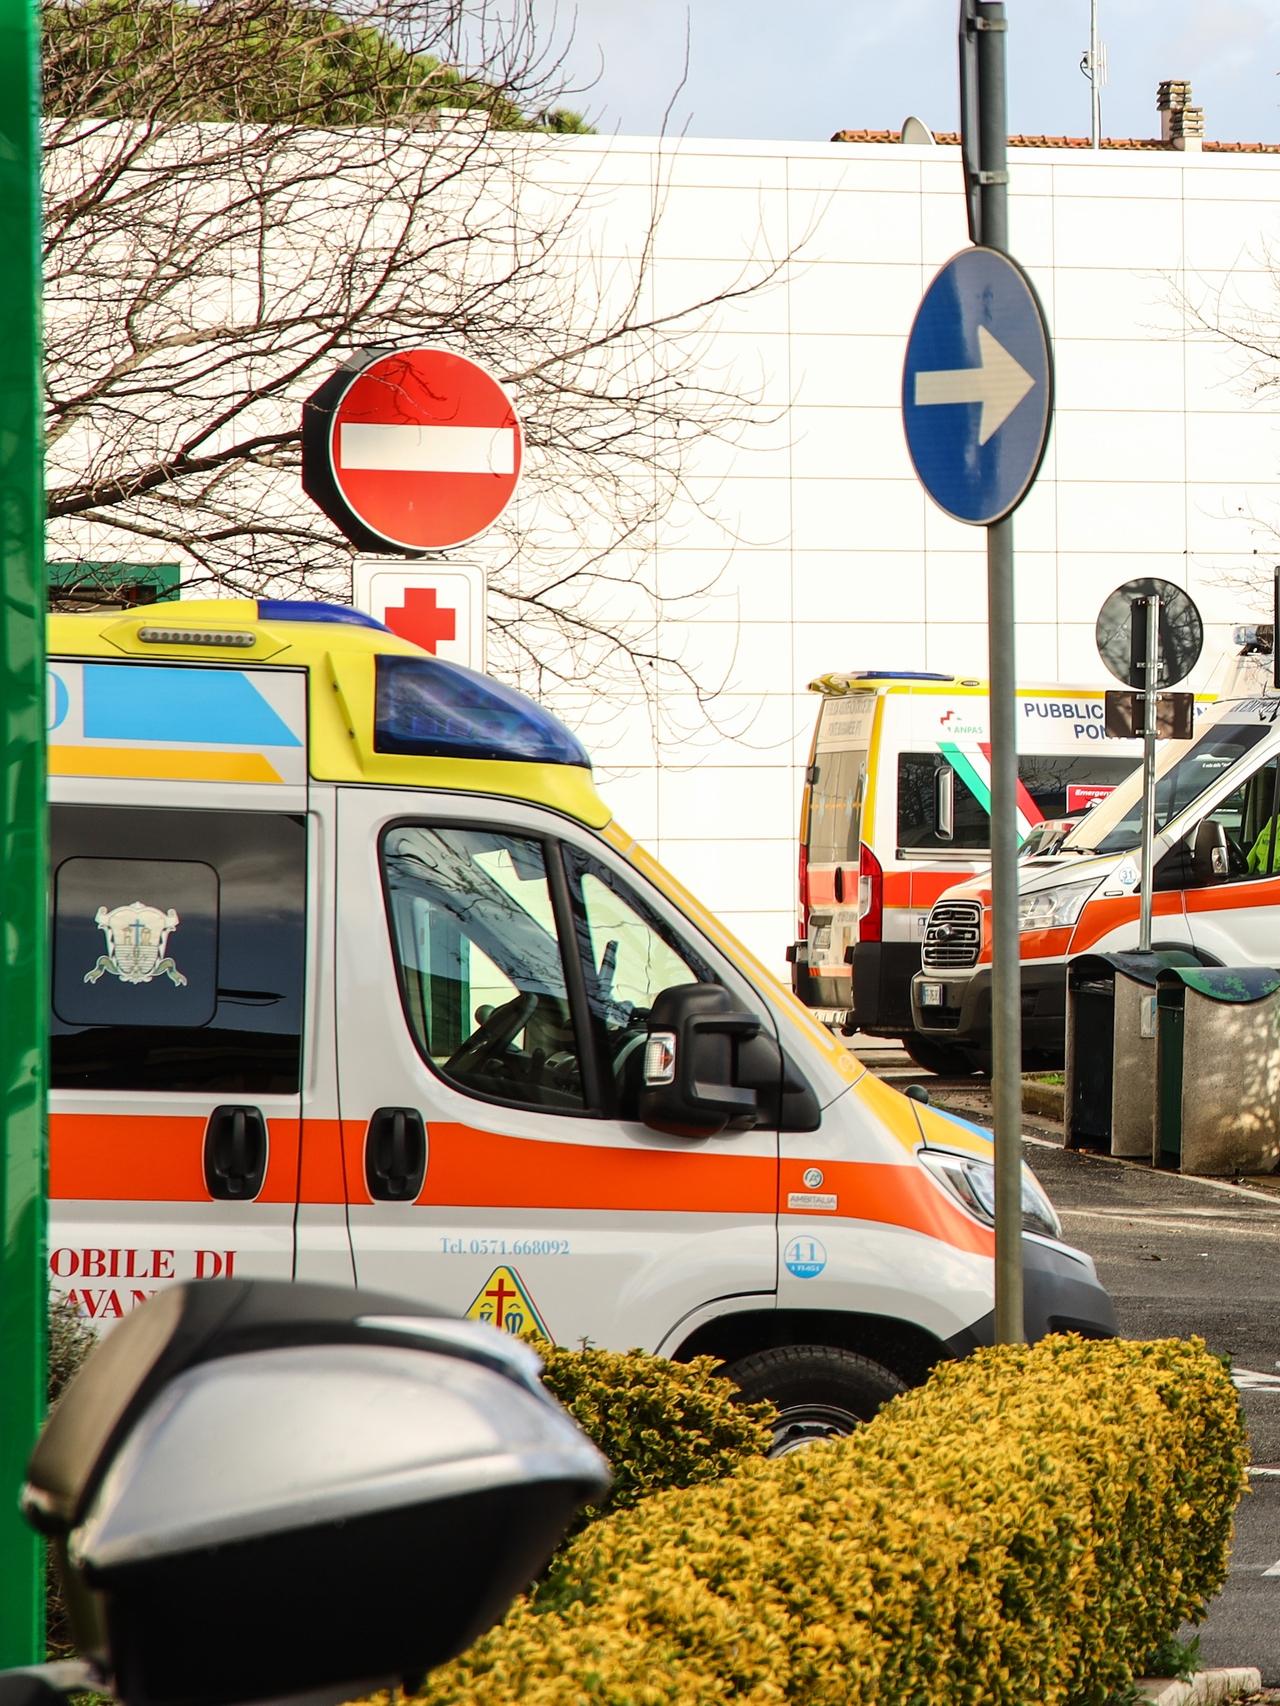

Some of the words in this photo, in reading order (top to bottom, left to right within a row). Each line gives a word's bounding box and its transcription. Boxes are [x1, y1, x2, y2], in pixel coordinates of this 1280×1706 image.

[1024, 703, 1104, 720] PUBBLIC
[953, 726, 983, 734] ANPAS
[1073, 724, 1107, 740] PON
[1075, 789, 1111, 797] Emergen
[440, 1237, 467, 1255] Tel.
[470, 1239, 570, 1256] 0571.668092
[788, 1242, 819, 1262] 41
[48, 1247, 175, 1278] OBILE
[192, 1250, 238, 1281] DI
